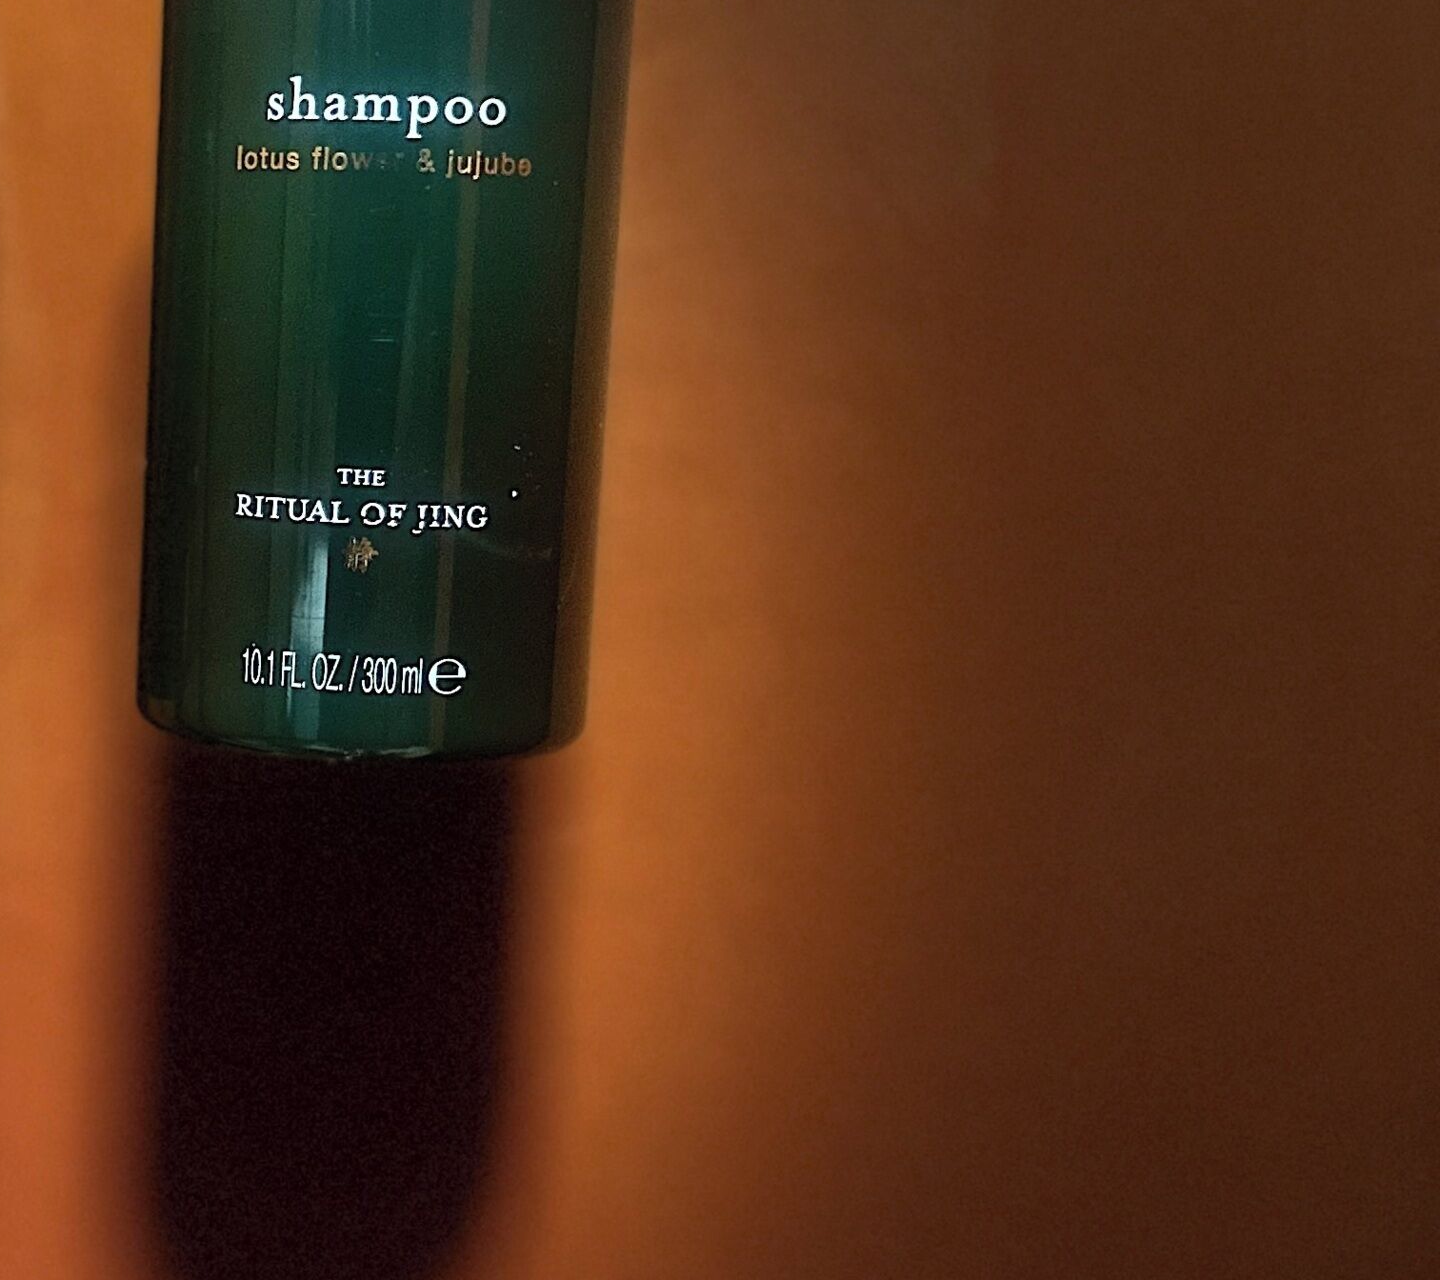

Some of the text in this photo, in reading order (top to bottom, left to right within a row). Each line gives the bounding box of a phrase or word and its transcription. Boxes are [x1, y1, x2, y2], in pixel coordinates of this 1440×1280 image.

[266, 75, 508, 139] shampoo
[236, 144, 533, 180] lotus flow & jujube
[336, 467, 386, 487] THE
[235, 493, 489, 534] RITUAL OF JING
[242, 646, 275, 686] 10.1
[361, 656, 397, 694] 300
